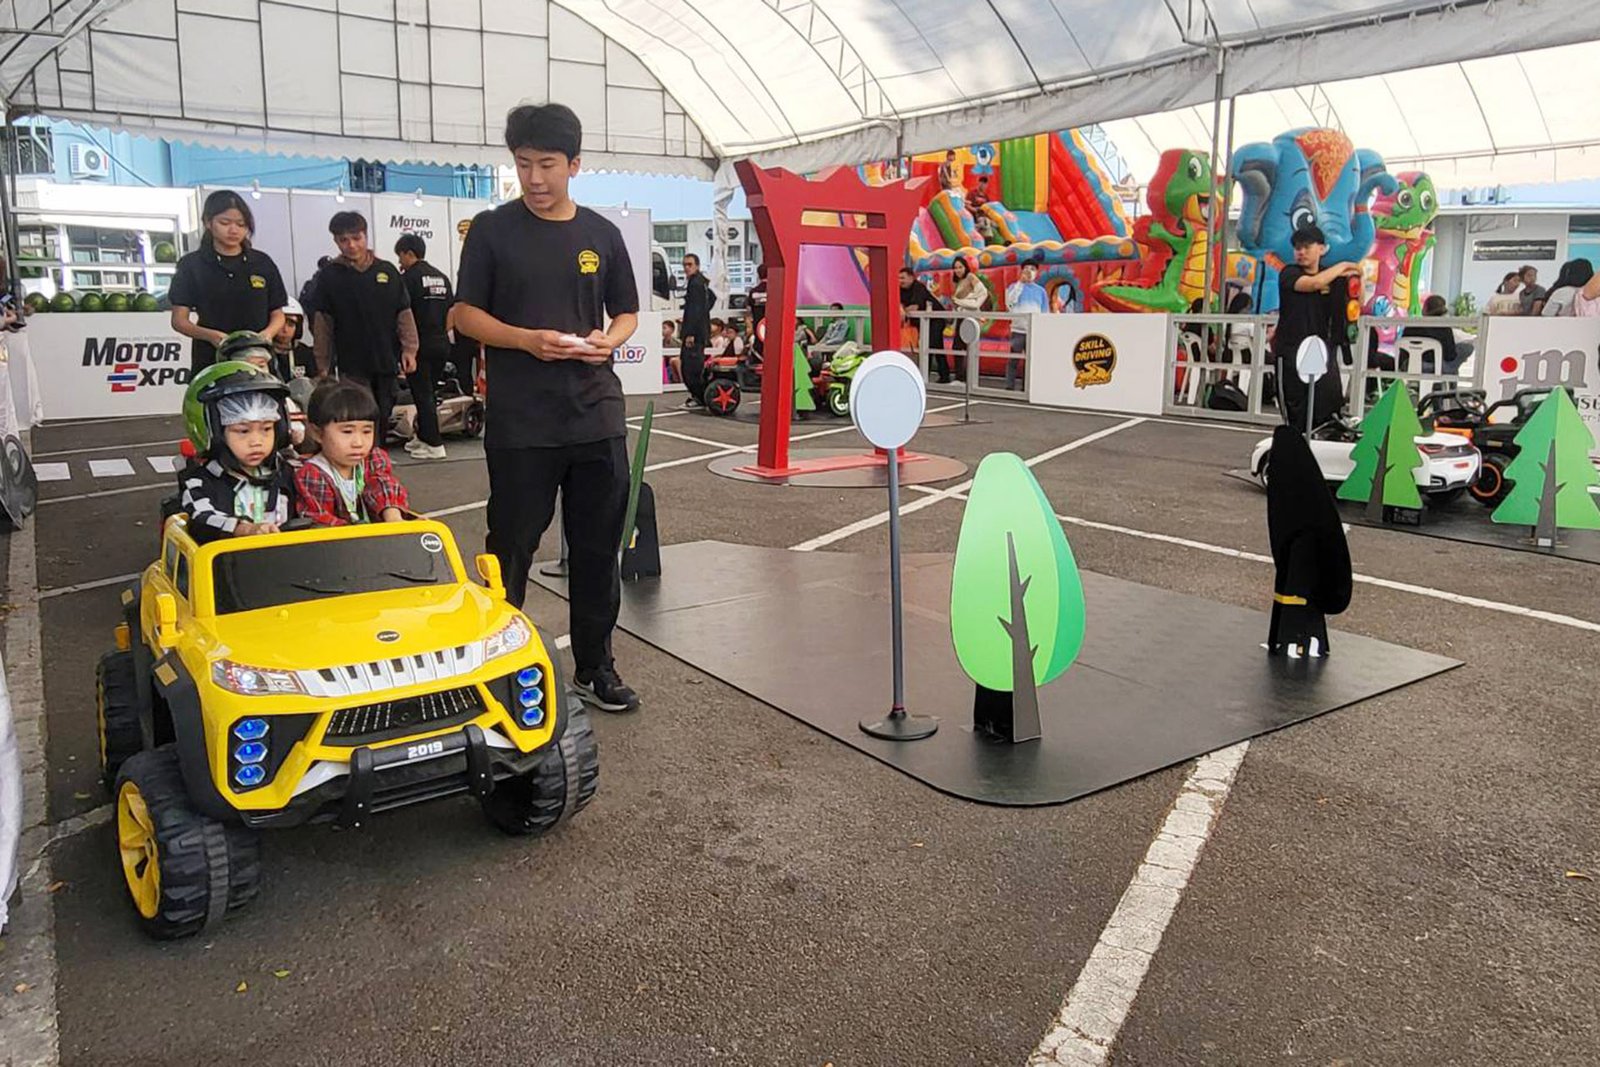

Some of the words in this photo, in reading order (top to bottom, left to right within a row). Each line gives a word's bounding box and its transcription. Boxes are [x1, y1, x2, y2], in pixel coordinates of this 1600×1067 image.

[82, 337, 182, 366] MOTOR
[1080, 340, 1105, 351] SKILL
[1075, 348, 1112, 362] DRIVING
[107, 363, 192, 392] EXPO
[408, 741, 443, 759] 2019
